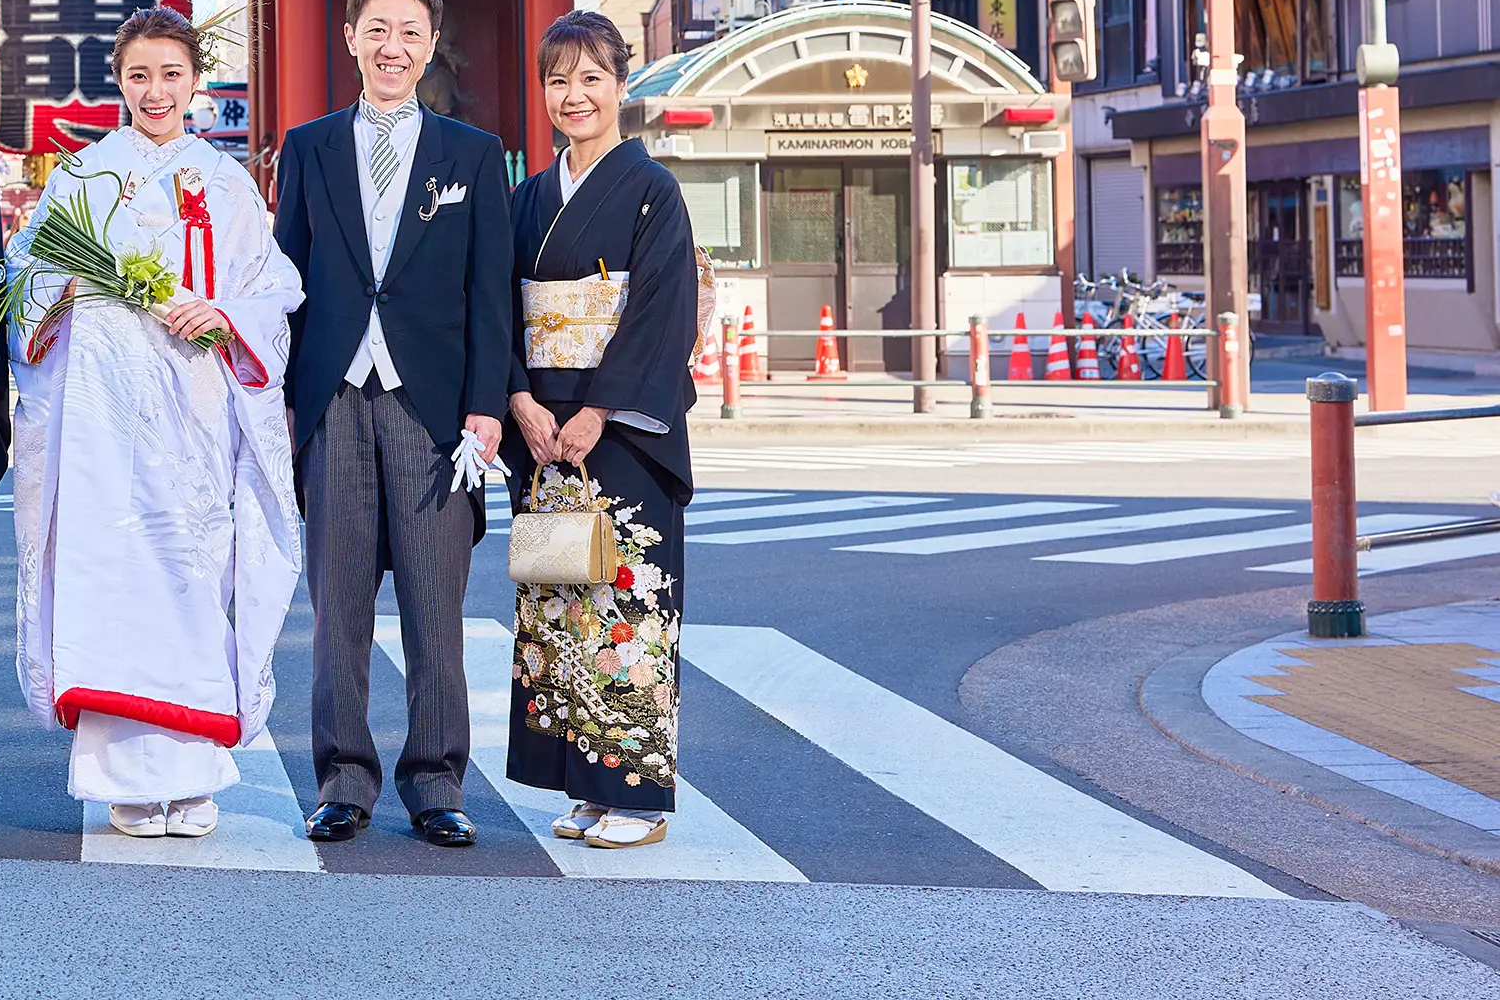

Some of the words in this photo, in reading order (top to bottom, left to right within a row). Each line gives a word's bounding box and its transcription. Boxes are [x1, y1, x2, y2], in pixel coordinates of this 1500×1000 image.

[222, 99, 246, 127] 仲
[777, 138, 874, 150] KAMINARIMON
[880, 138, 912, 150] KOB
